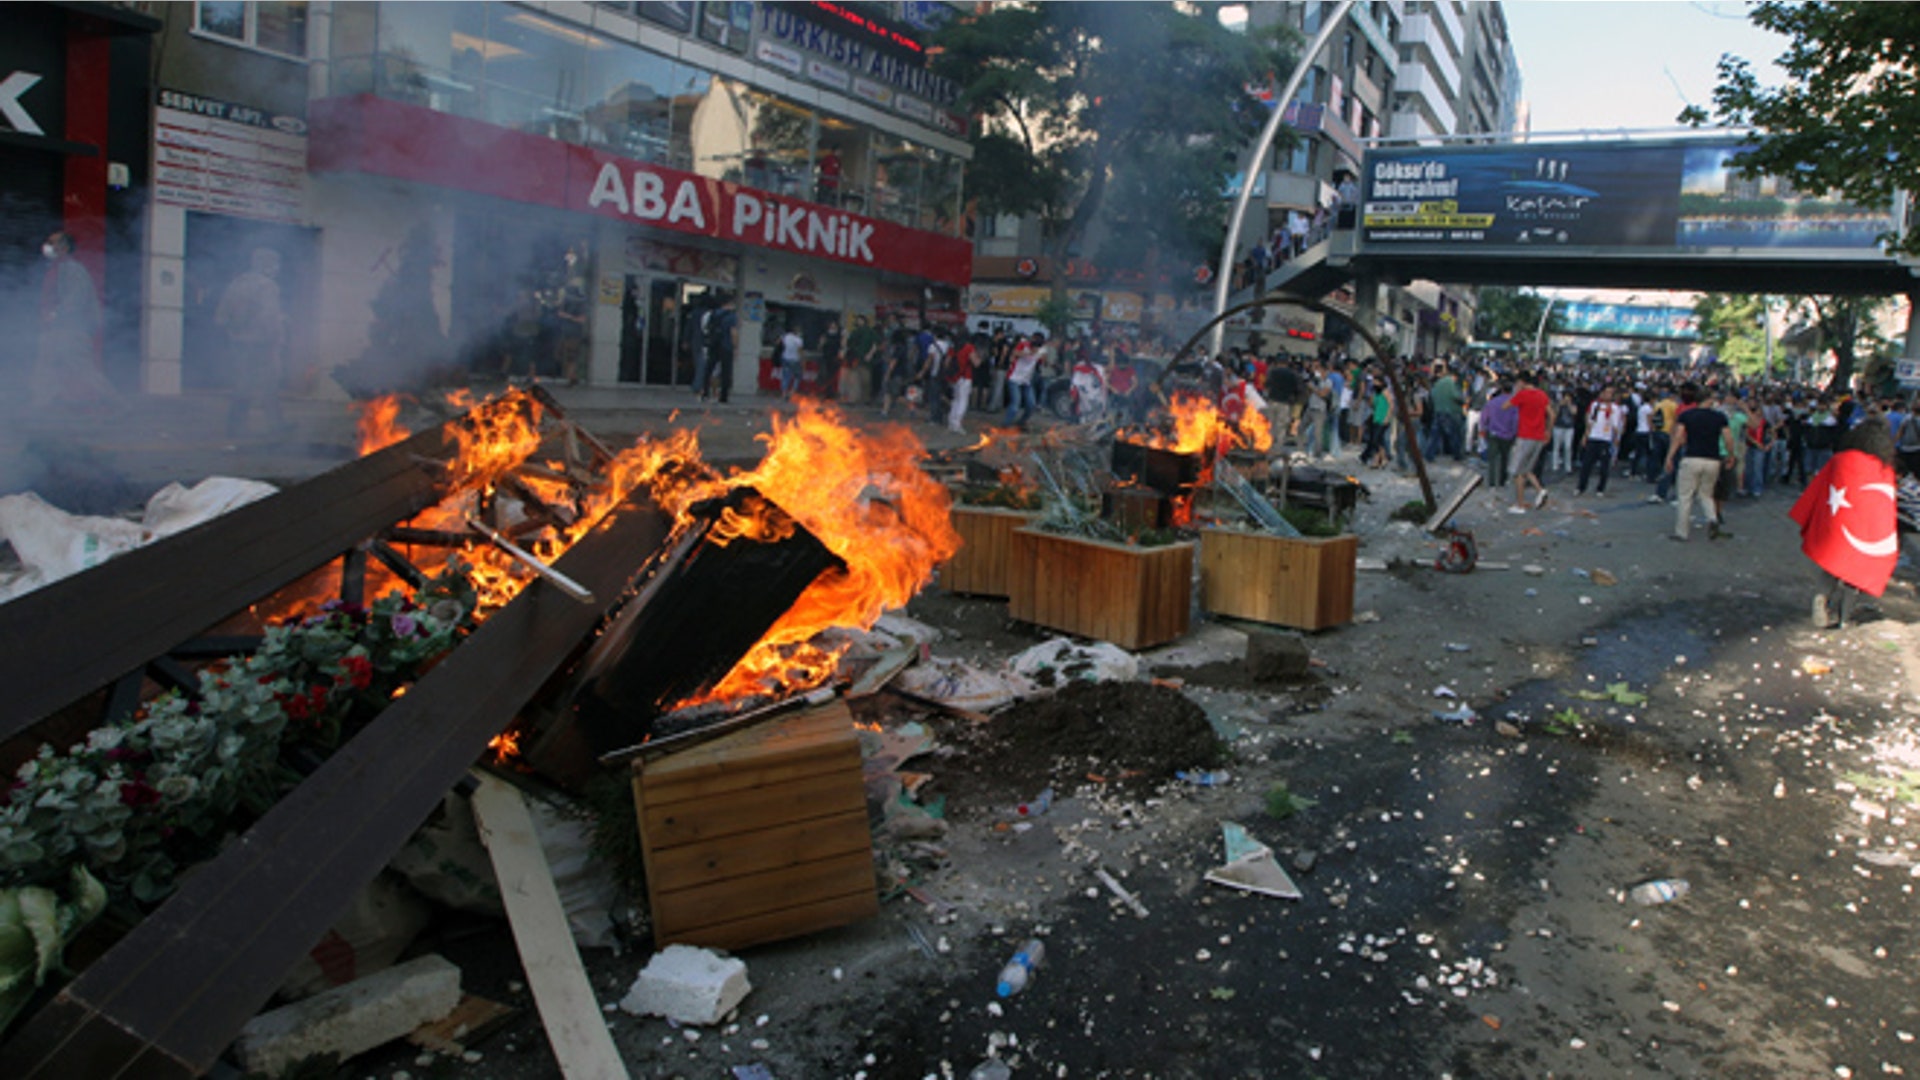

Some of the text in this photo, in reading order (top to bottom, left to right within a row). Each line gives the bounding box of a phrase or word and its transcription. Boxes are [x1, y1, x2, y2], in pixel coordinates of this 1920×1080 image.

[760, 5, 863, 70] TURKISH
[867, 48, 965, 107] AIRLINES
[161, 90, 226, 117] SERVET
[229, 106, 267, 127] APT.
[589, 163, 705, 229] ABA
